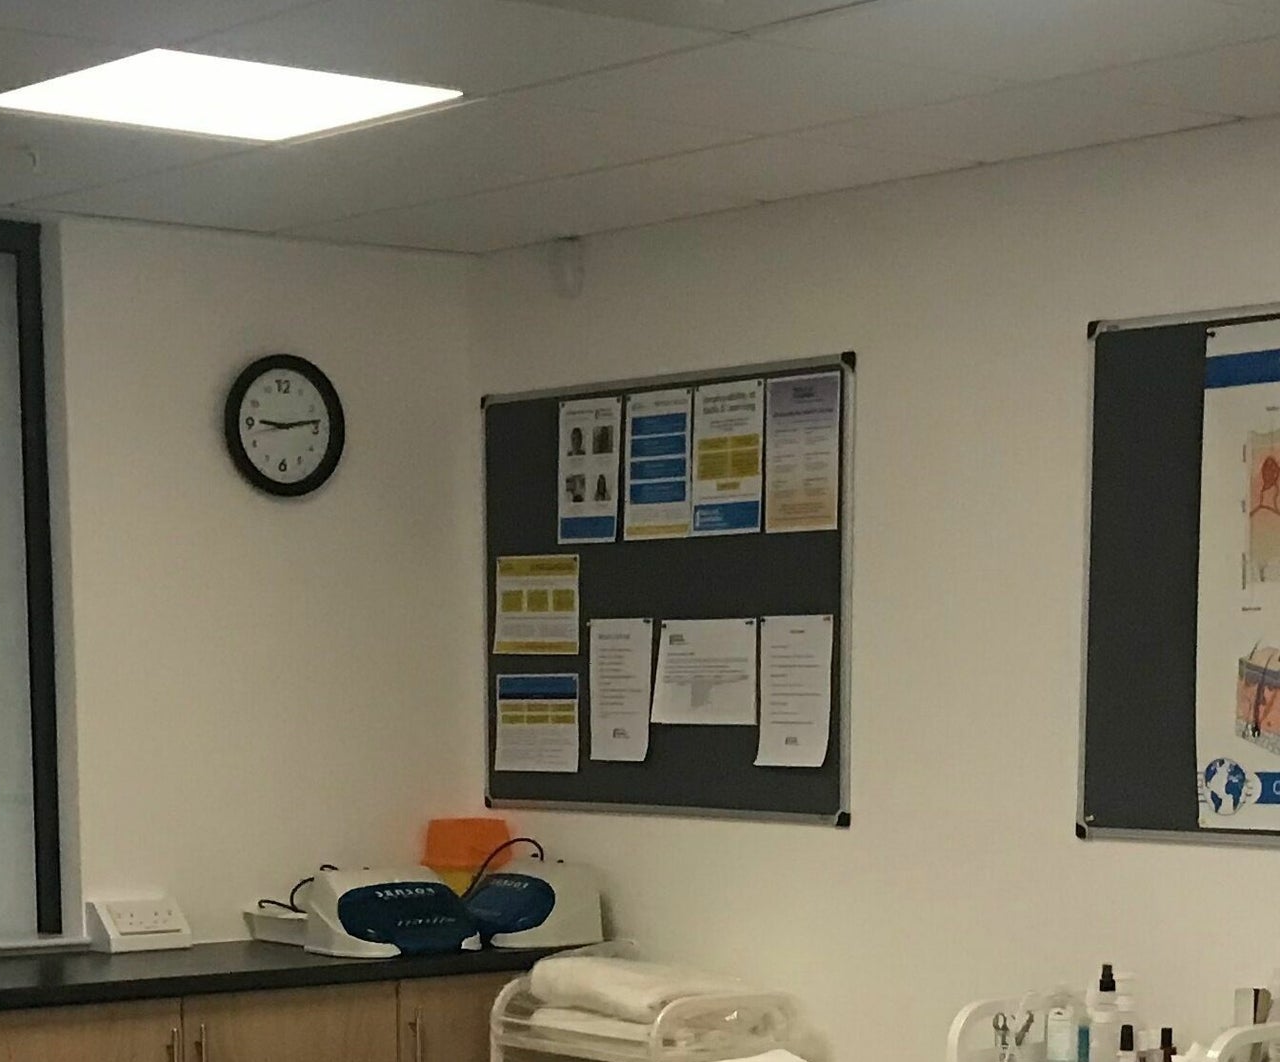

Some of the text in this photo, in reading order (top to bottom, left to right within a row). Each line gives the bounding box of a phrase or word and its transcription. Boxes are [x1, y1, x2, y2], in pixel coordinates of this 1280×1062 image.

[275, 379, 291, 394] 12
[245, 416, 255, 430] 9
[278, 458, 288, 472] 6
